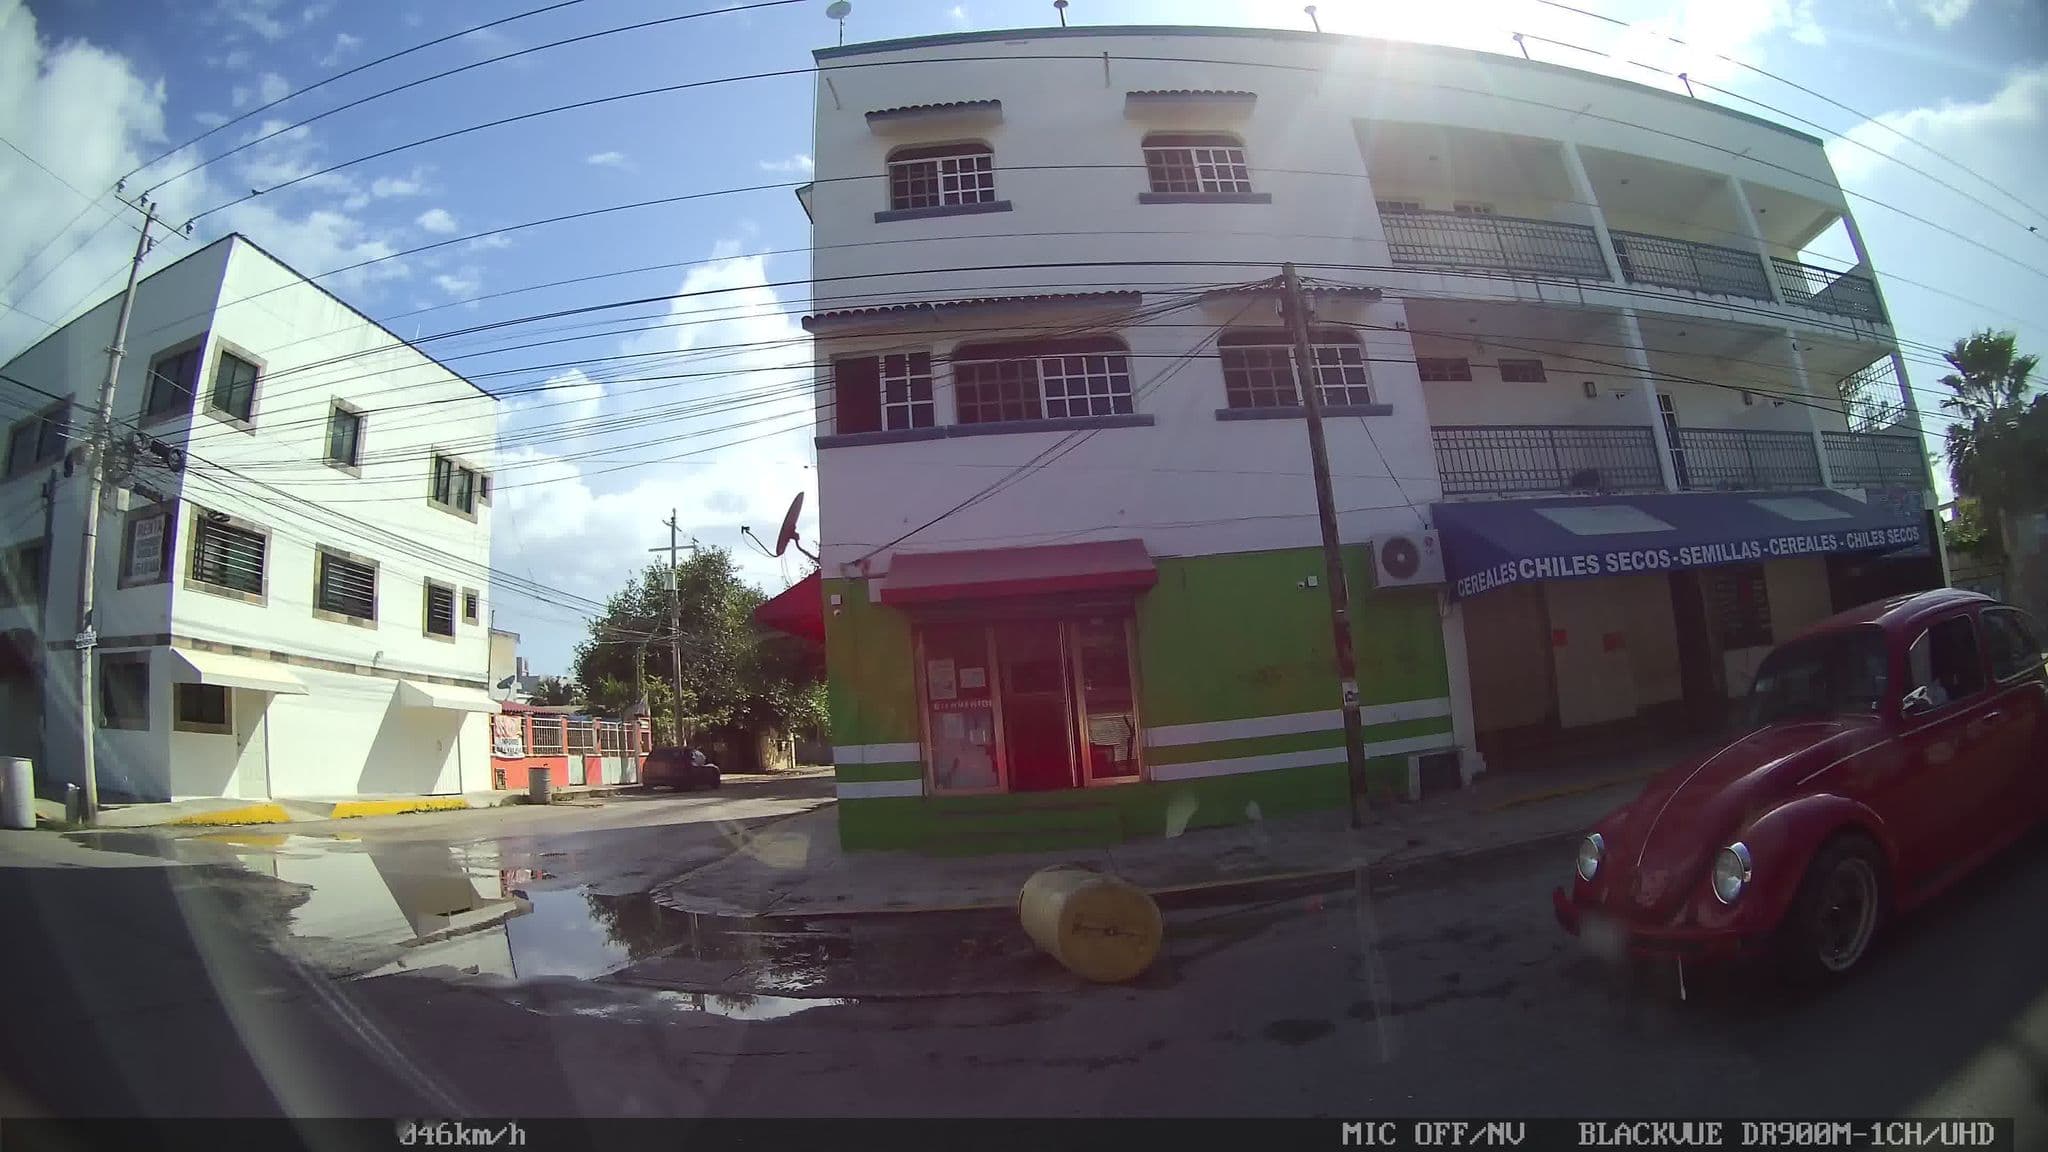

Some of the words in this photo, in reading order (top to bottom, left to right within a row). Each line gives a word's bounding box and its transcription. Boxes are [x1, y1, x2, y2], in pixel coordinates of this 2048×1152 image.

[1519, 554, 1600, 578] CHILES
[1846, 530, 1886, 549] CHILES
[1887, 526, 1920, 544] SECOS
[1457, 560, 1518, 597] CEREALES
